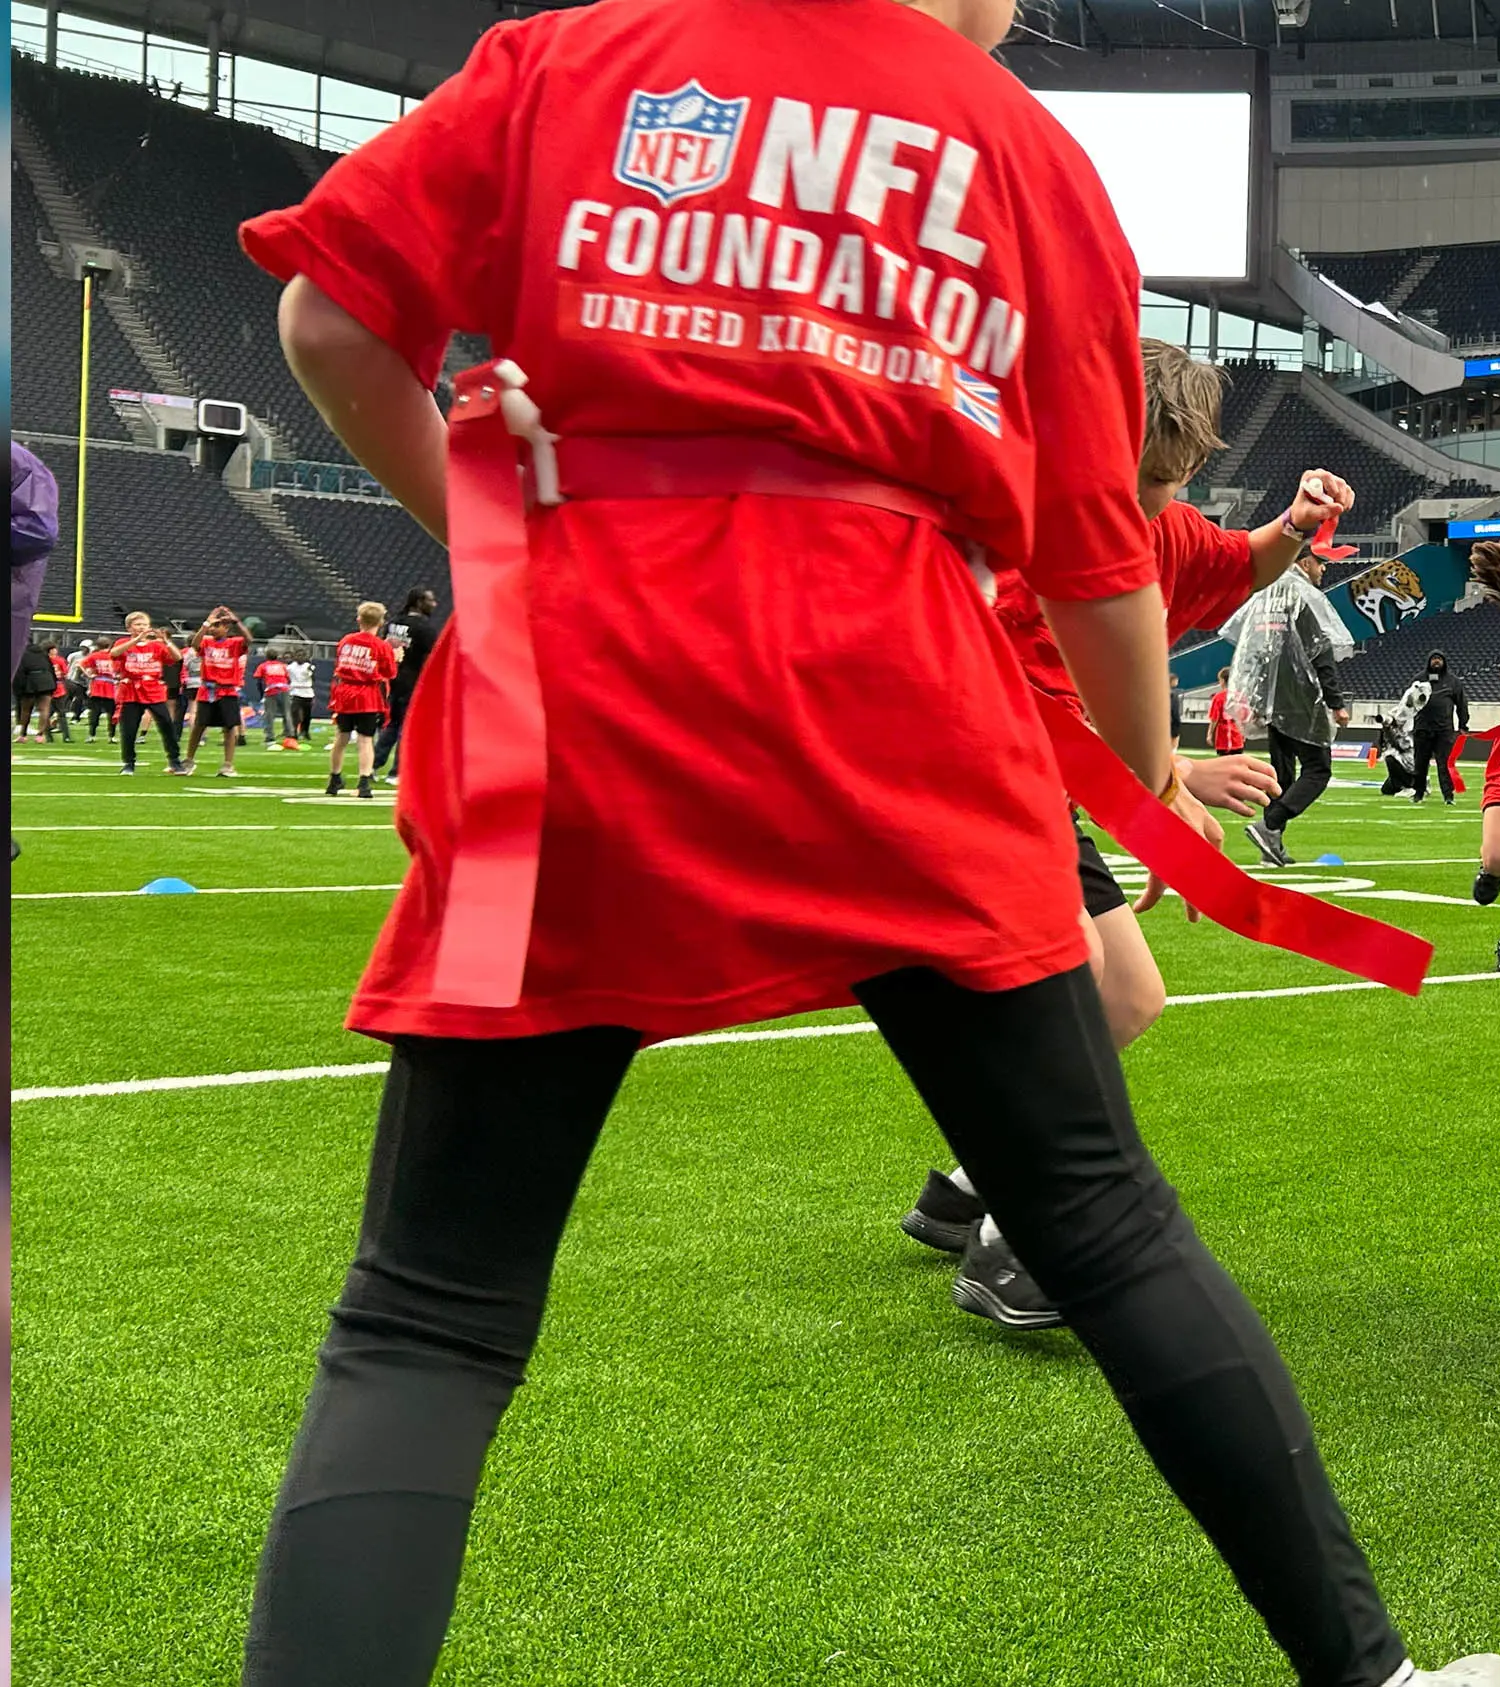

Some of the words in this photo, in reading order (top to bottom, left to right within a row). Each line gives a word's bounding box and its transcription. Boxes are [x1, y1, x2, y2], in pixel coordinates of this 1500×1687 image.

[628, 133, 720, 183] NFL
[748, 97, 986, 270] NFL
[557, 200, 1025, 378] FOUNDATION
[580, 293, 745, 349] UNITED
[758, 312, 944, 391] KINGDOM
